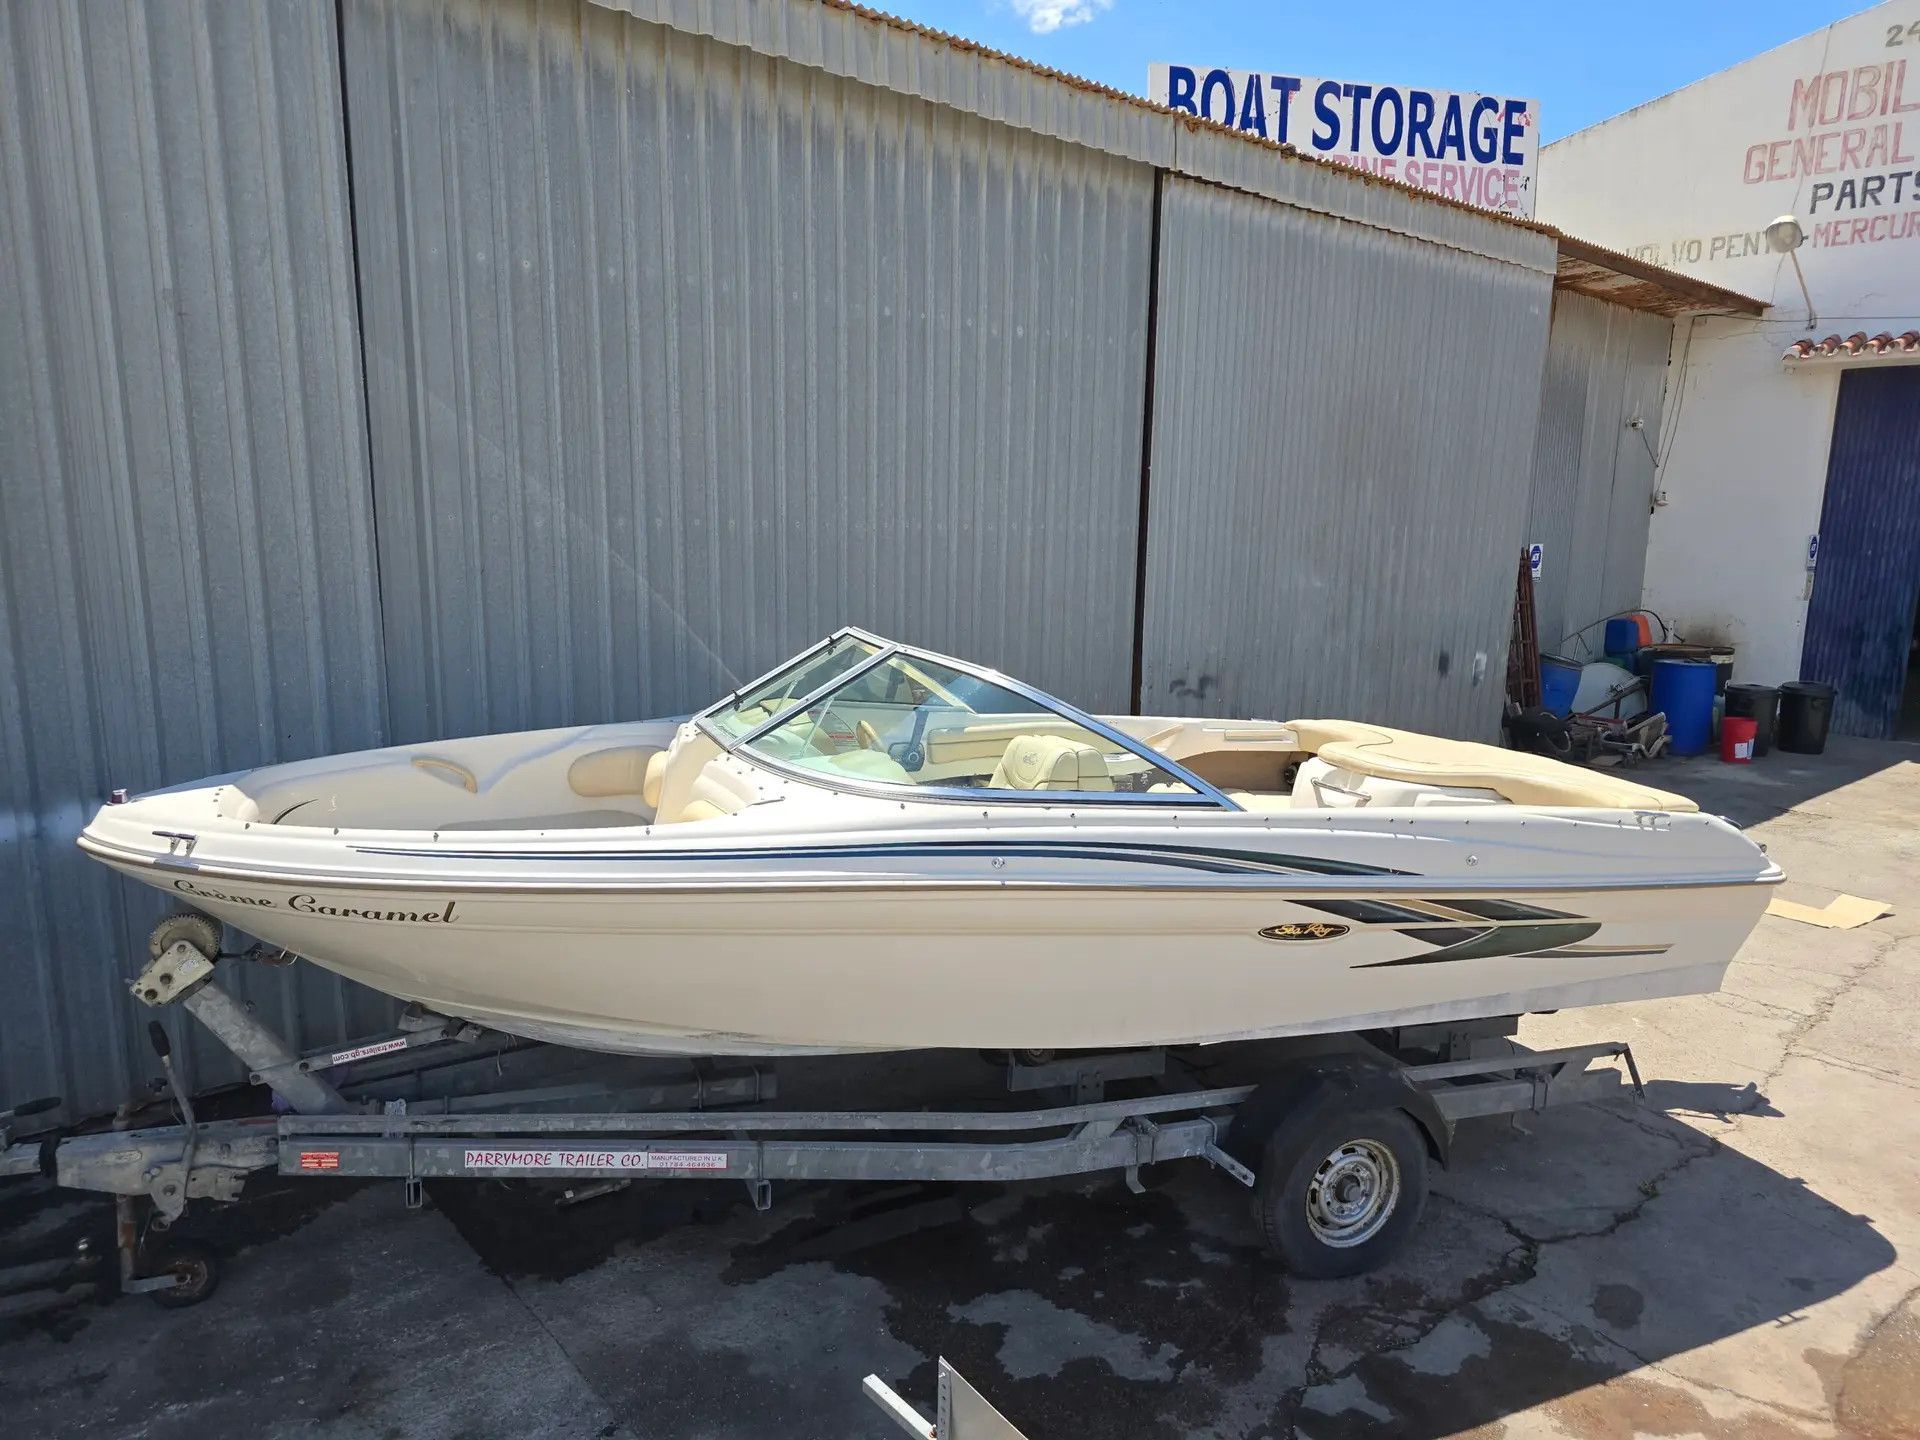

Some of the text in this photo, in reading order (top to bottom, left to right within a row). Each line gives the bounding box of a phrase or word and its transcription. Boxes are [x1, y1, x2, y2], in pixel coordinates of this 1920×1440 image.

[1168, 65, 1527, 166] BOAT STORAGE
[1743, 122, 1915, 184] GENERAL
[1404, 160, 1520, 209] SERVICE
[288, 894, 460, 923] Caramel
[466, 1152, 644, 1167] PARRYMORE TRAILER CO.
